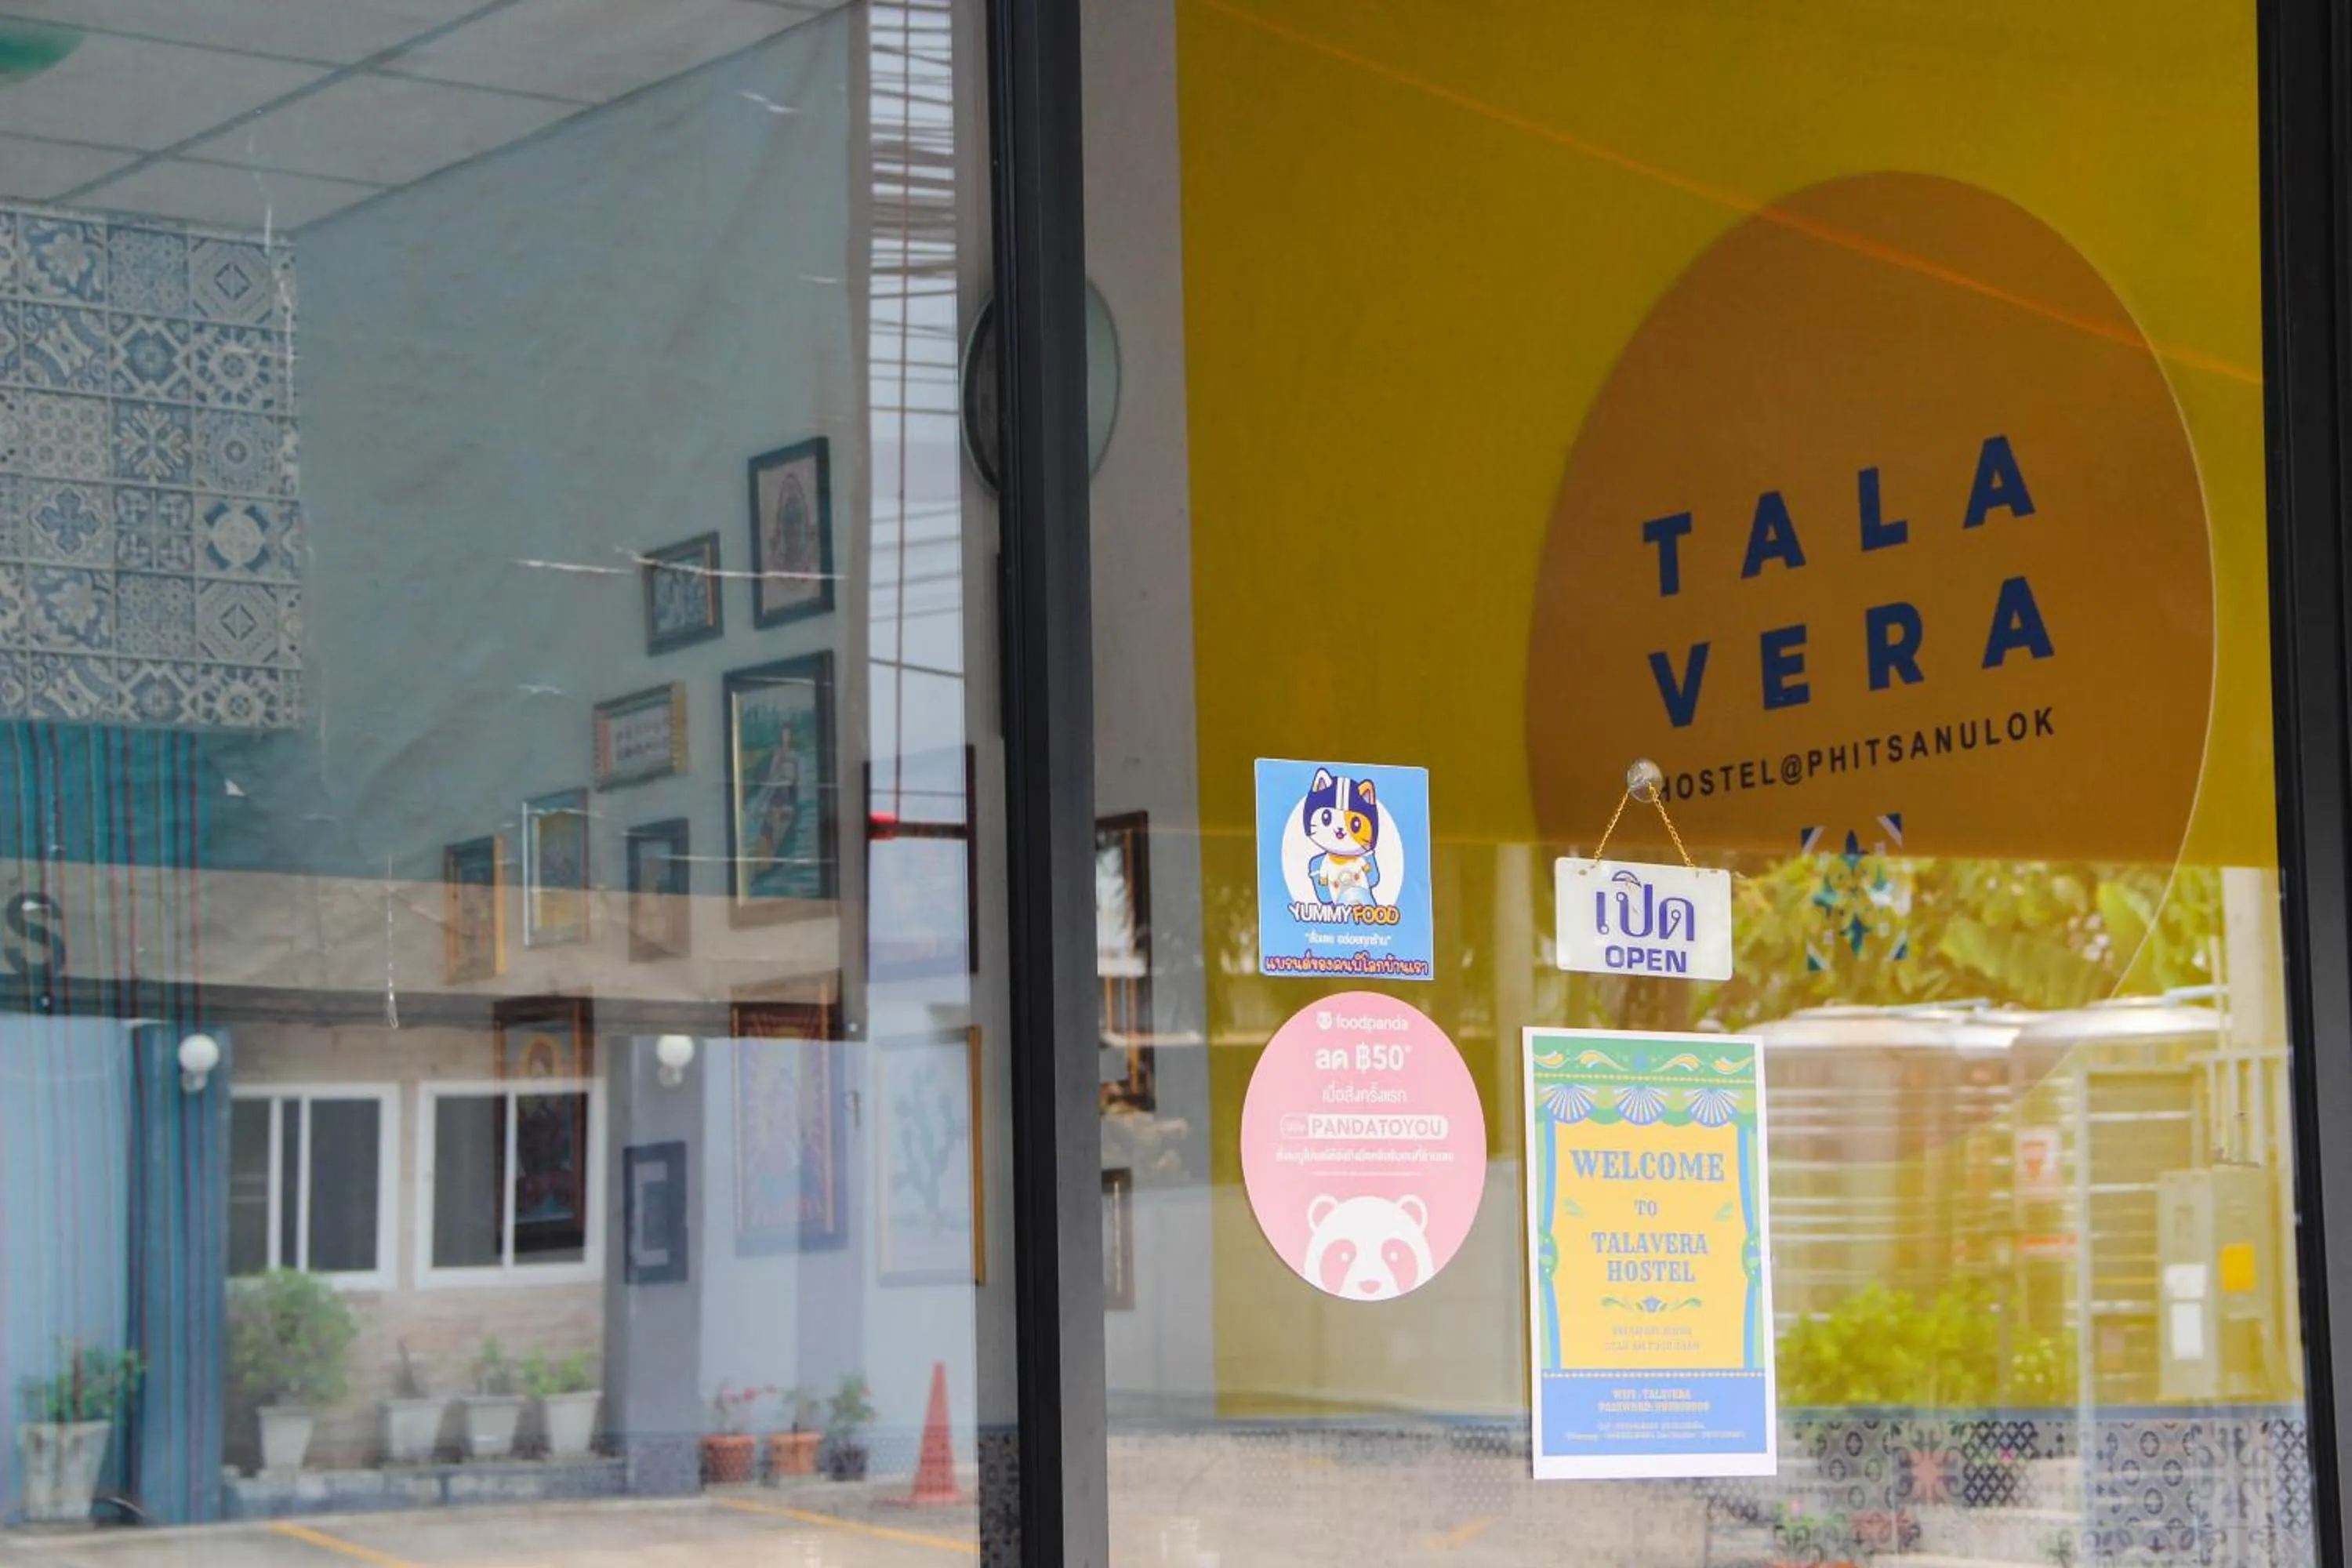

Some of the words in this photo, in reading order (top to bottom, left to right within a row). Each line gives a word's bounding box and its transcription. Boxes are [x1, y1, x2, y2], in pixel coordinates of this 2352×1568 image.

[1643, 435, 2035, 597] TALA
[1649, 575, 2055, 728] VERA
[1596, 870, 1694, 942] เปิด
[1605, 946, 1687, 973] OPEN
[1336, 1012, 1409, 1033] foodpanda
[1315, 1048, 1348, 1071] ลด
[1312, 1118, 1442, 1137] PANDATOYOU
[1570, 1150, 1725, 1181] WELCOME
[1634, 1200, 1658, 1216] TO
[1591, 1232, 1708, 1254] TALAVERA
[1606, 1260, 1696, 1283] HOSTEL
